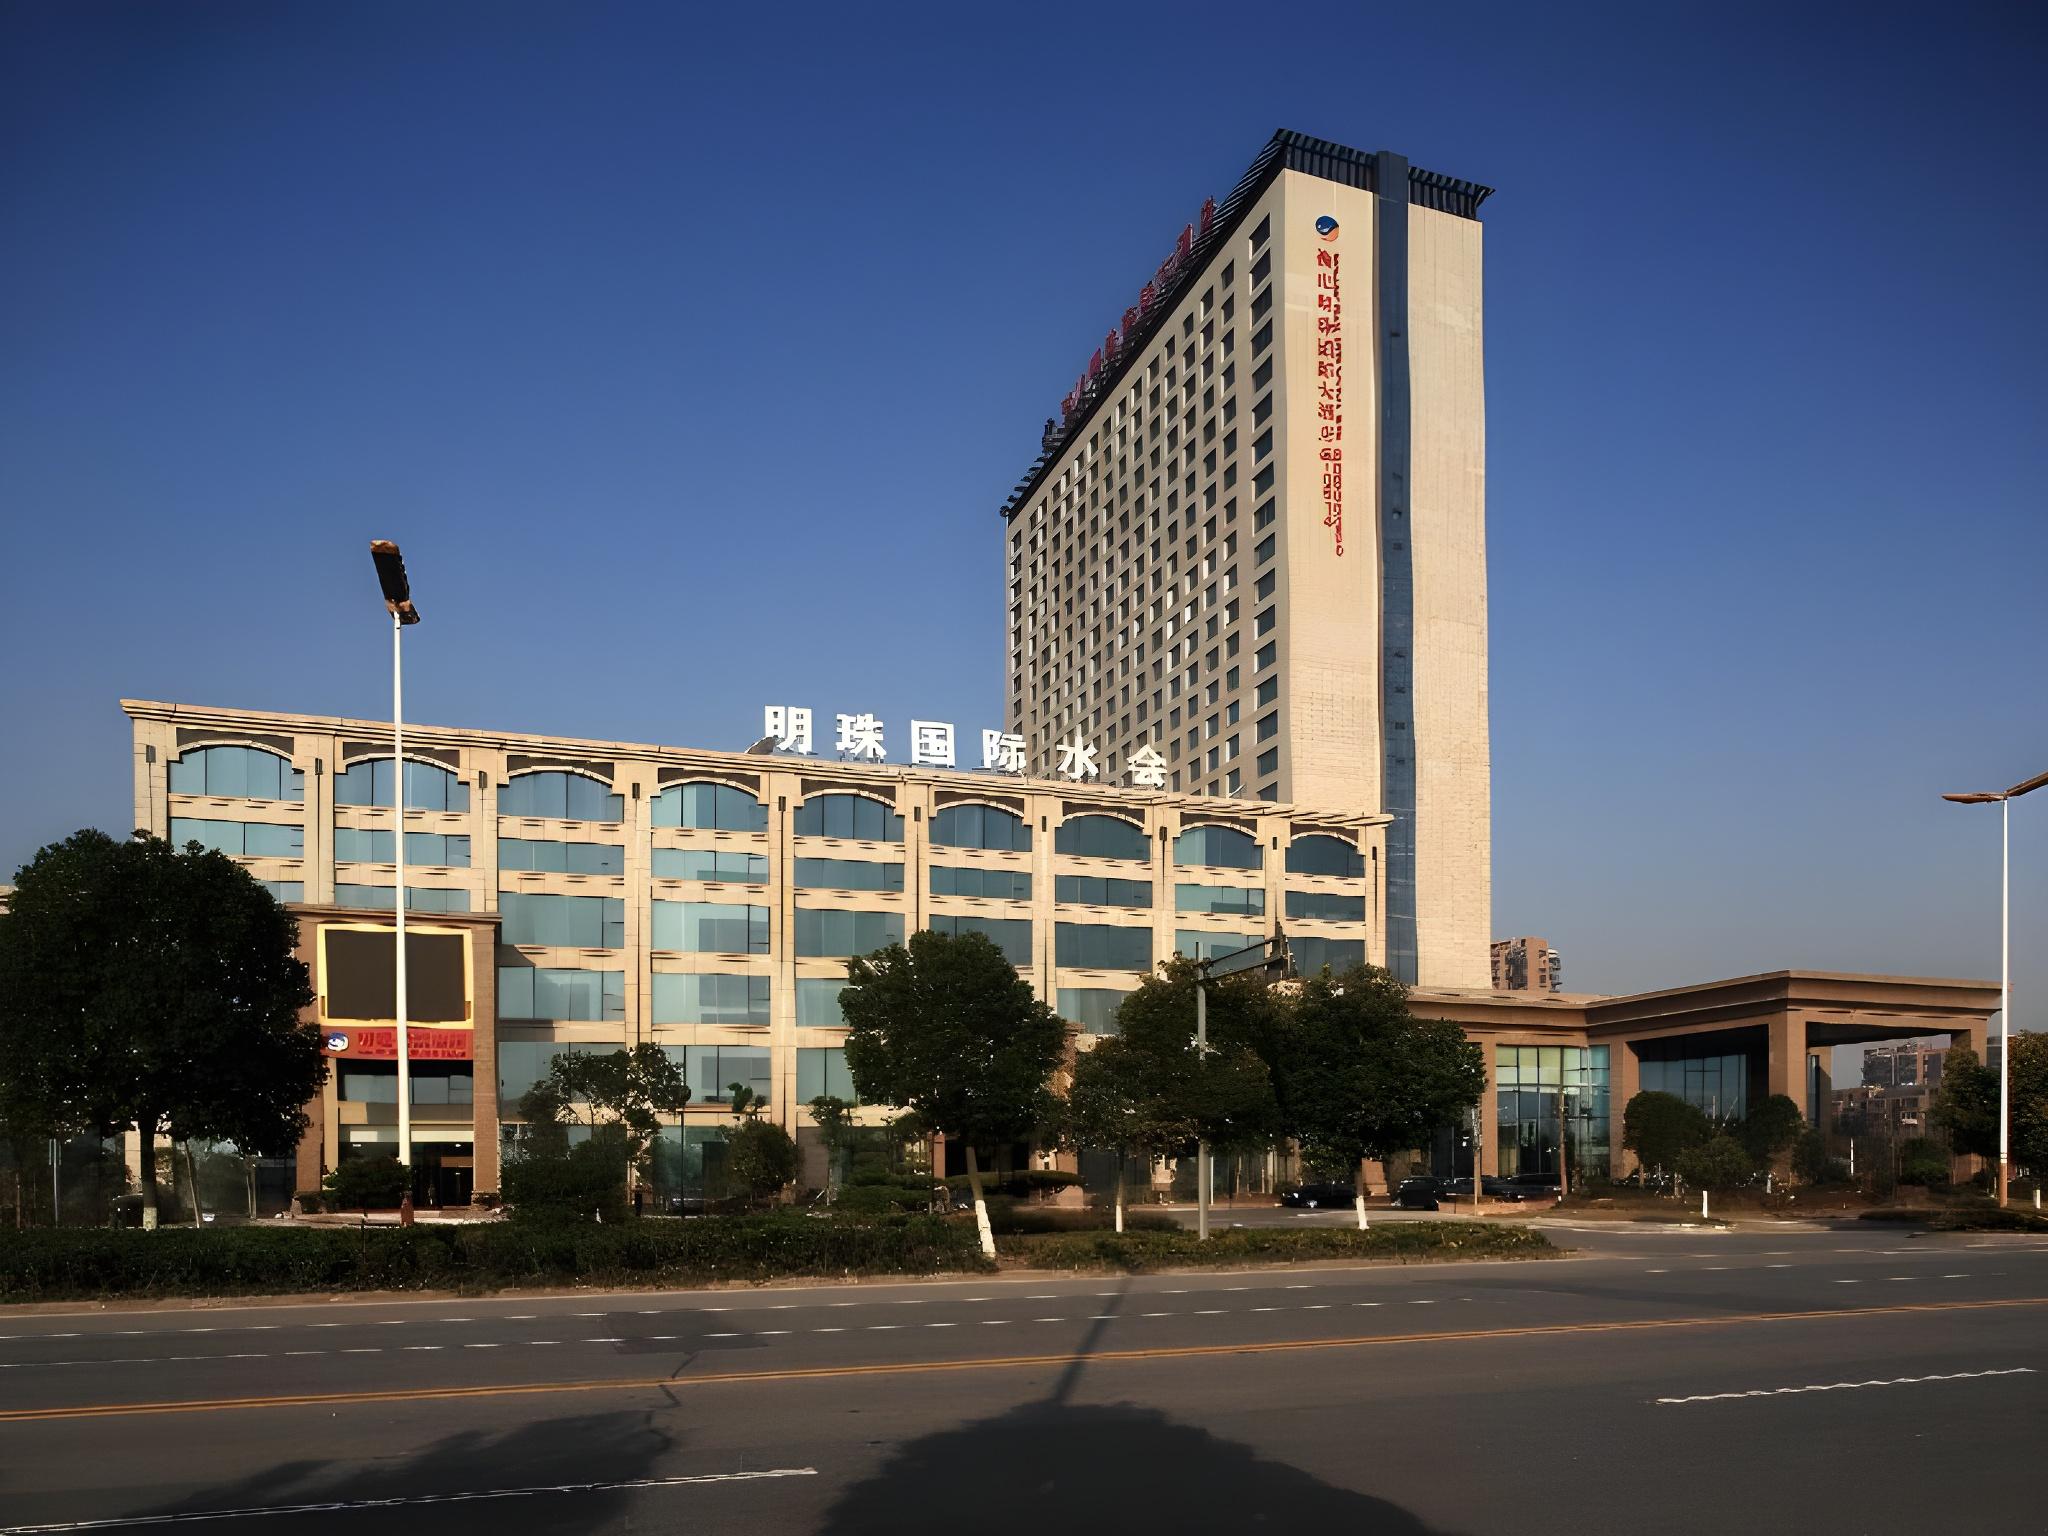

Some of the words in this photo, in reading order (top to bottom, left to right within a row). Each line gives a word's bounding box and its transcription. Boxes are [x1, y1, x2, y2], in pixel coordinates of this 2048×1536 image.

[764, 705, 1168, 787] 明珠国际水会
